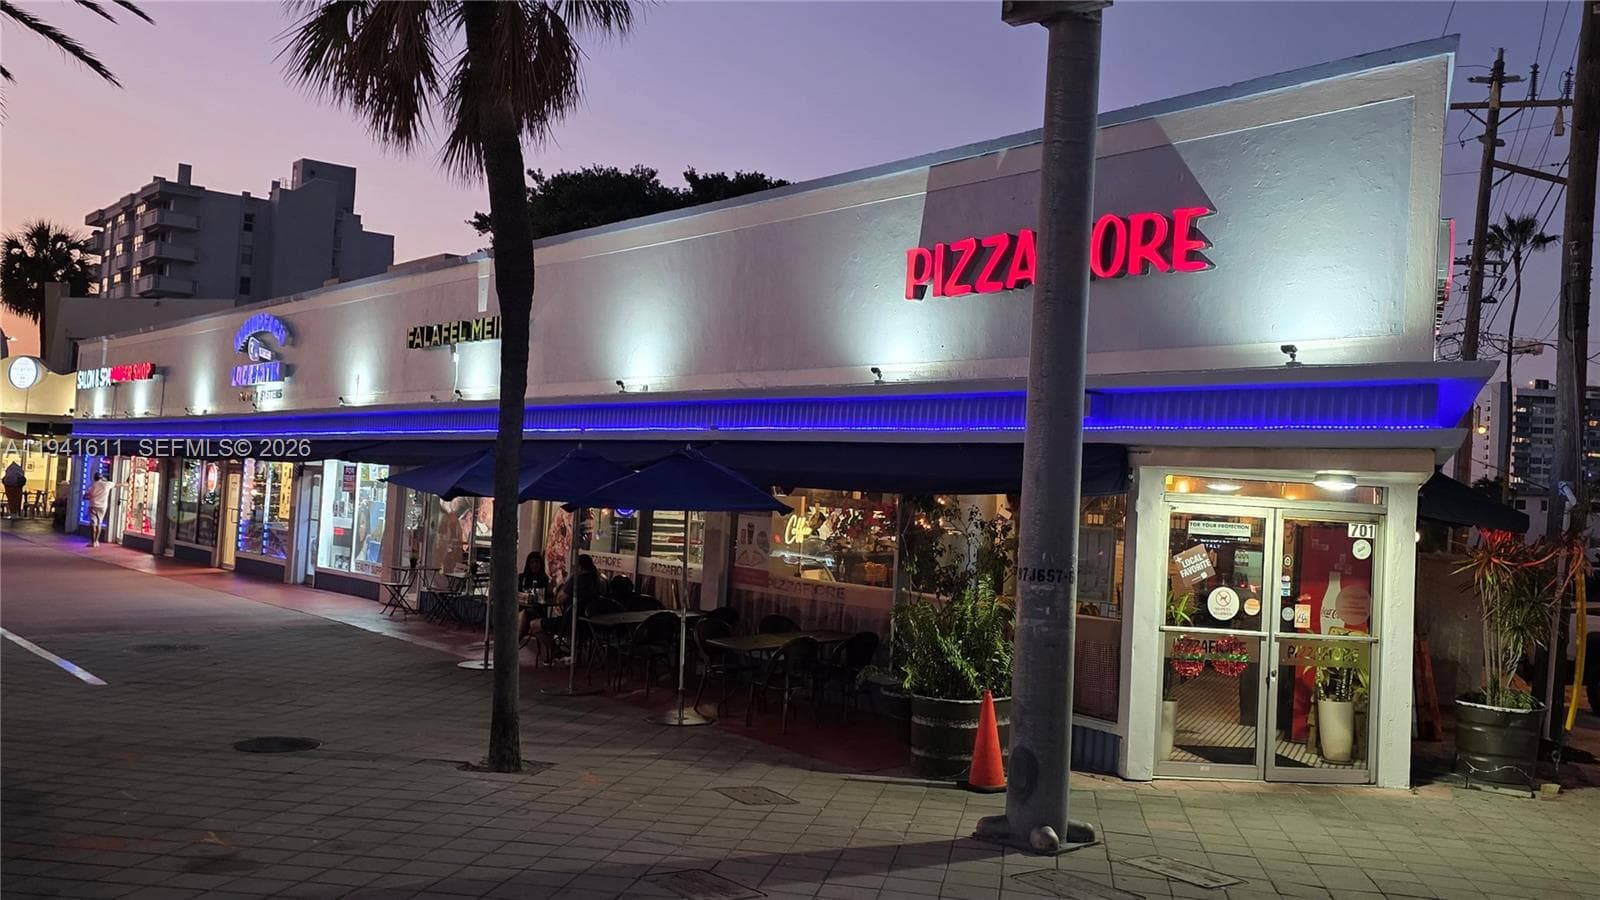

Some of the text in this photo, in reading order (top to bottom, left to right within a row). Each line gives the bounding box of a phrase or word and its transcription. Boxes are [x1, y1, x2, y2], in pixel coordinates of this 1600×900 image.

[905, 206, 1216, 301] PIZZAORE
[406, 315, 502, 349] FALAFEL MEI
[1351, 524, 1374, 538] 701
[591, 554, 623, 568] ZZAFIORE
[1180, 558, 1212, 578] FAVORITE
[1181, 553, 1204, 568] LOCAL
[650, 562, 693, 578] PIZZAFIOE
